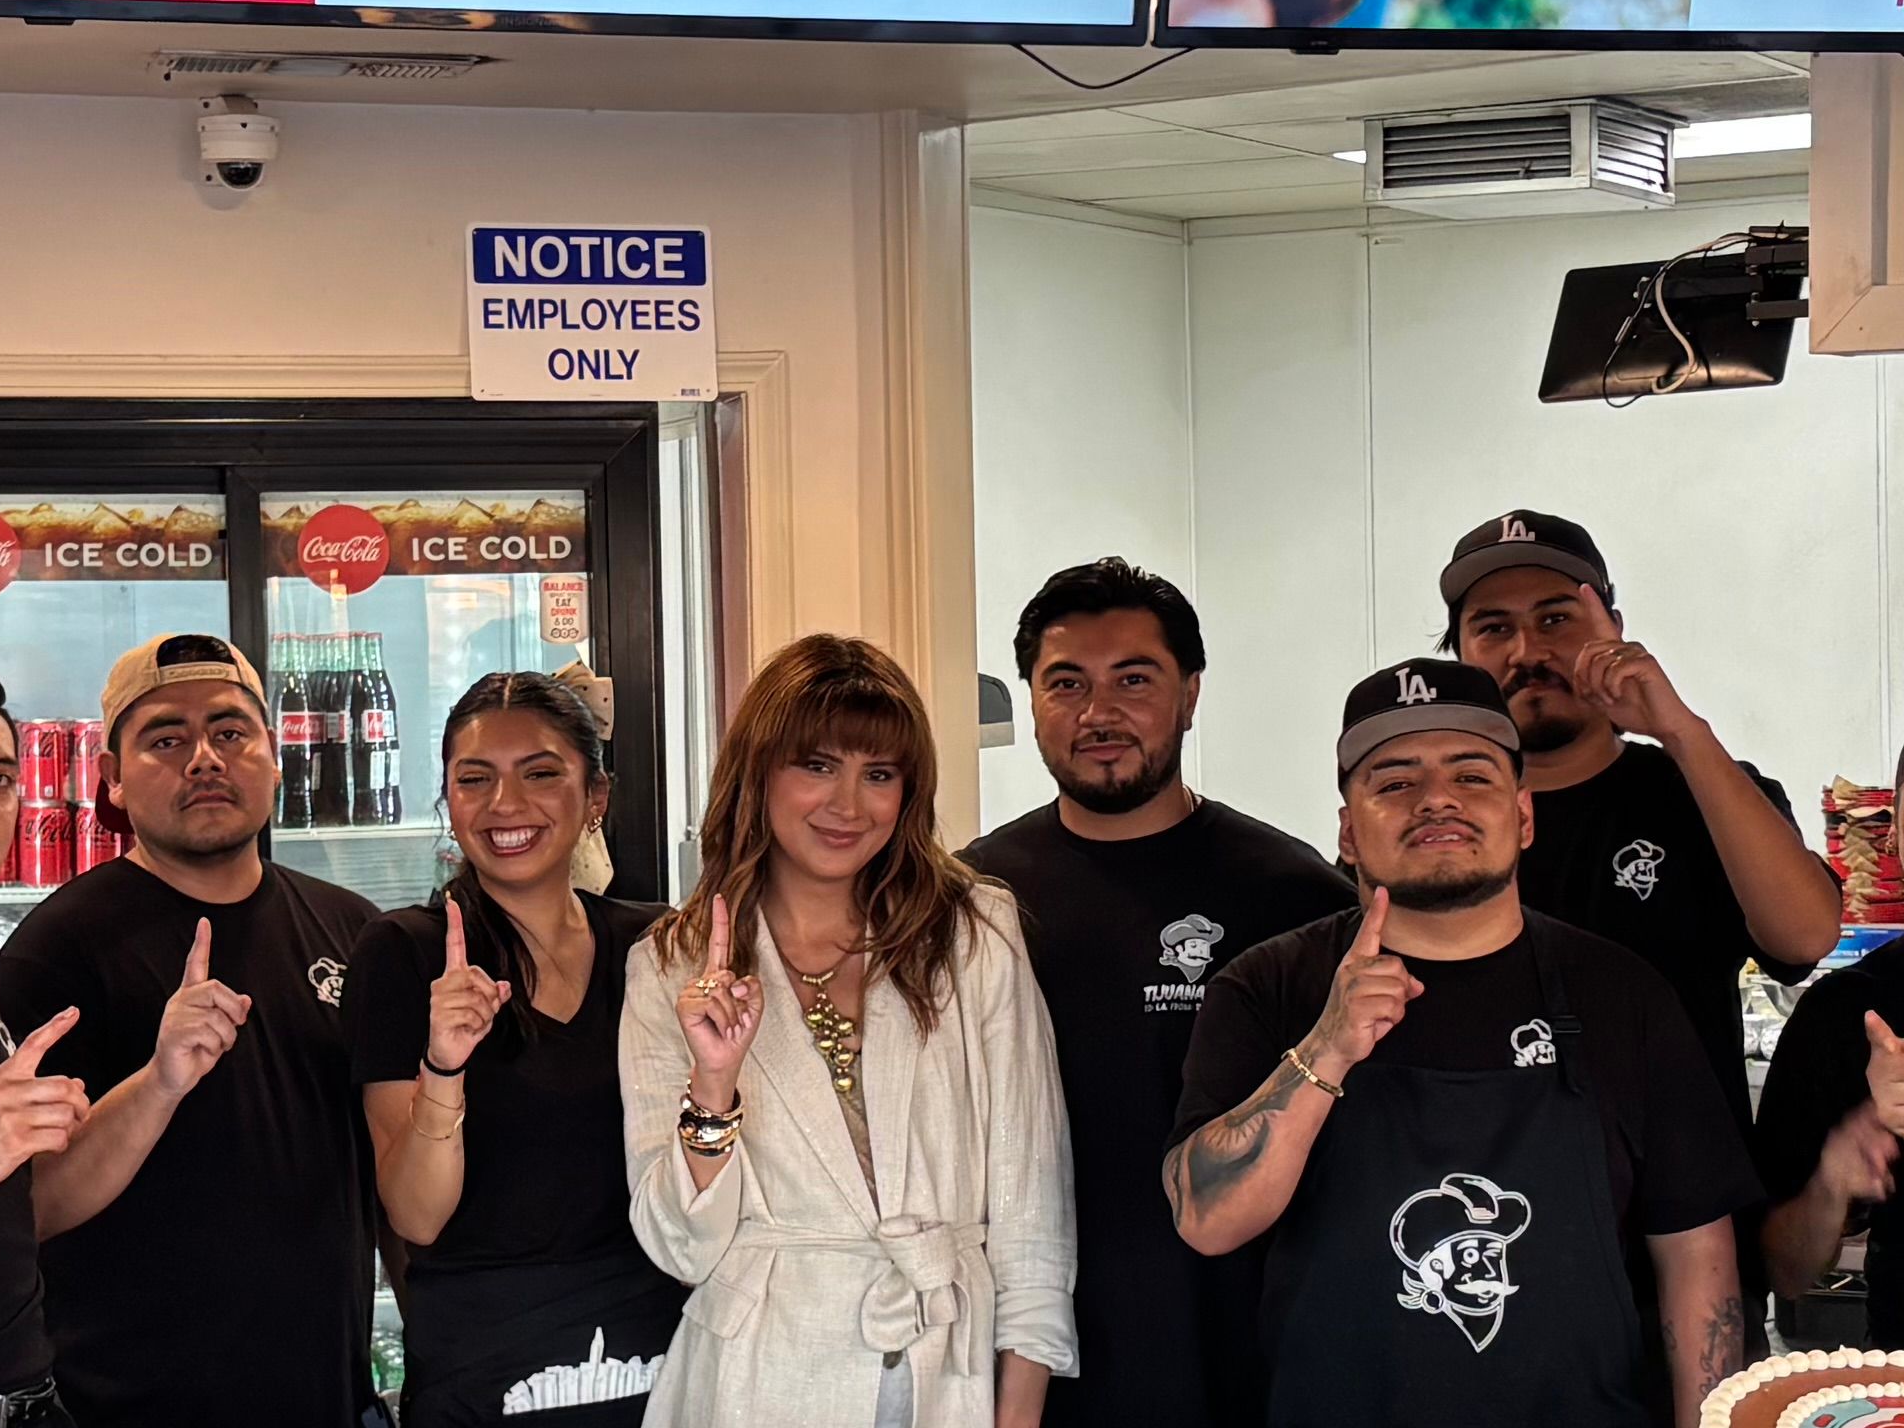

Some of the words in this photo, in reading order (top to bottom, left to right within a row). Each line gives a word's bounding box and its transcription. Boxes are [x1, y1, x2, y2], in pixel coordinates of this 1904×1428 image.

[494, 235, 686, 279] NOTICE
[483, 298, 701, 331] EMPLOYEES
[548, 348, 639, 380] ONLY
[1498, 515, 1536, 543] LA
[45, 542, 104, 567] ICE
[116, 542, 212, 568] COLD
[302, 535, 384, 563] Coca-Cola
[412, 537, 468, 561] ICE
[480, 536, 571, 560] COLD
[1395, 667, 1438, 705] LA
[1143, 984, 1205, 1002] TIJUANA
